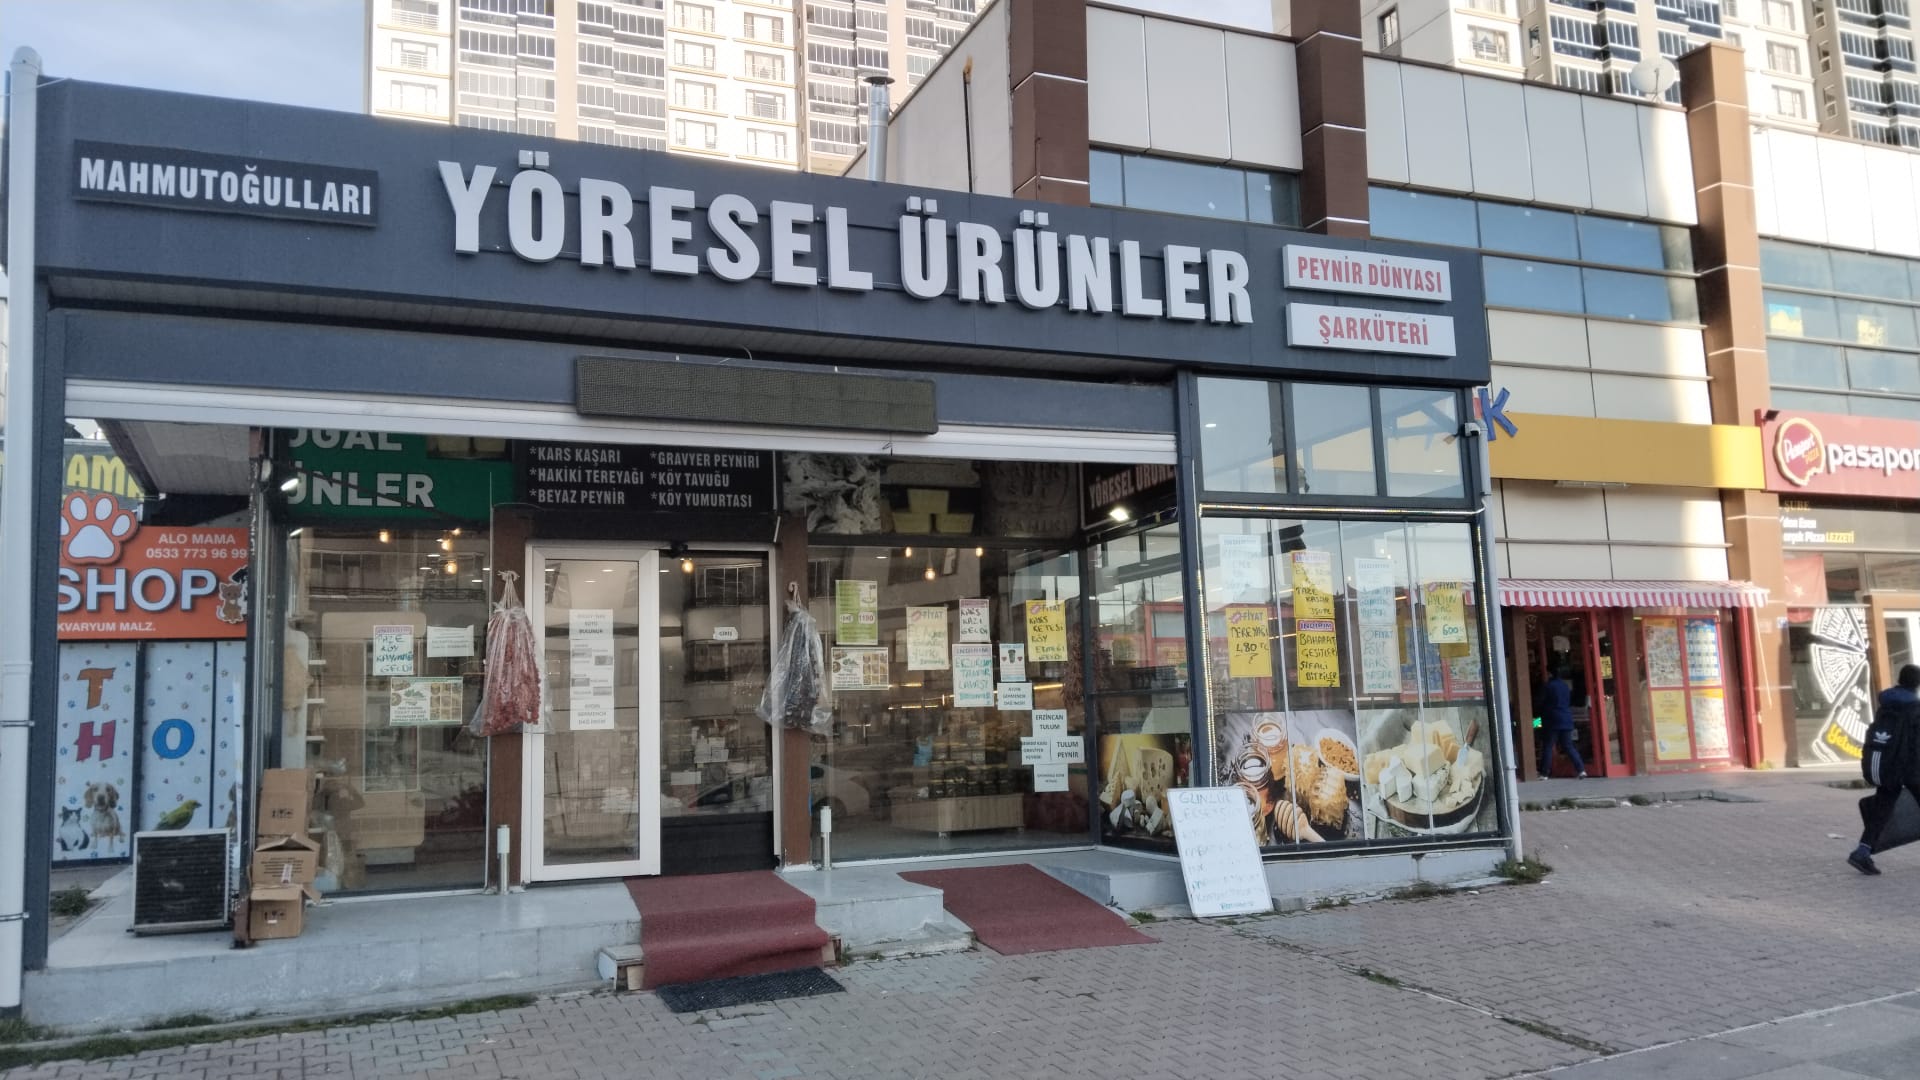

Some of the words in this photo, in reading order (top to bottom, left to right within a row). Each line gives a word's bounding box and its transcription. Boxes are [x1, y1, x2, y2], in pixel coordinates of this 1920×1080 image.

[80, 157, 371, 216] MAHMUTOĞULLARI
[438, 149, 874, 291] YÖRESEL
[899, 196, 1254, 325] ÜRÜNLER
[1297, 255, 1363, 285] PEYNİR
[1368, 259, 1443, 293] DÜNYASI
[1318, 313, 1429, 346] ŞARKÜTERİ
[538, 447, 571, 463] KARS
[575, 448, 621, 467] KAŞARI
[658, 451, 711, 467] GRAVYER
[714, 453, 760, 469] PEYNİRİ
[538, 466, 582, 482] HAKİKİ
[586, 467, 644, 485] TEREYAĞI
[659, 470, 681, 486] KÖY
[685, 471, 730, 487] TAVUĞU
[538, 488, 577, 504] BEYAZ
[580, 487, 625, 505] PEYNİR
[659, 489, 682, 506] KÖY
[685, 493, 752, 508] YUMURTASI
[1089, 470, 1134, 510] YÖRESEL
[159, 534, 187, 544] ALO
[192, 534, 235, 544] MAMA
[146, 548, 179, 559] 0533
[182, 548, 207, 559] 773
[211, 549, 227, 559] 96
[231, 549, 248, 559] 99
[120, 622, 156, 632] MALZ.
